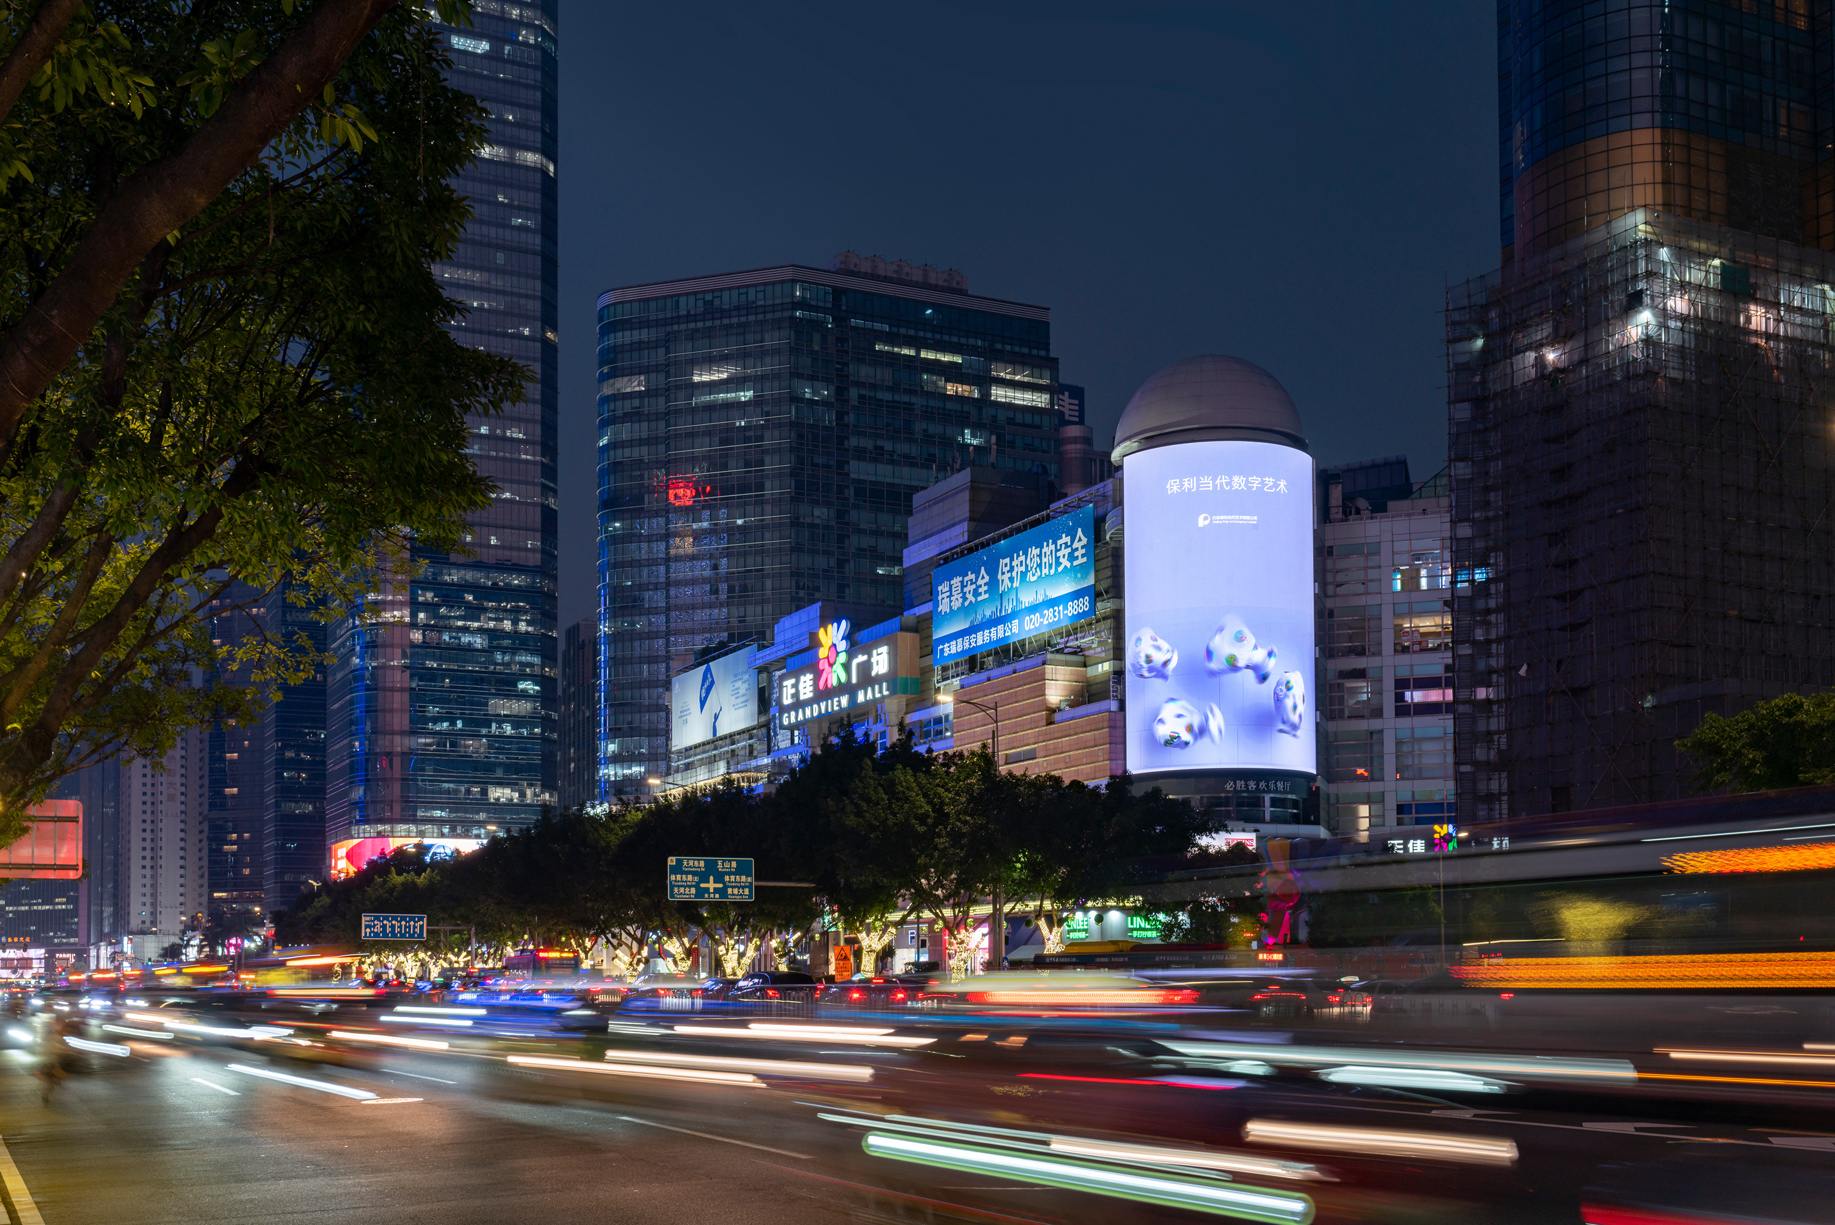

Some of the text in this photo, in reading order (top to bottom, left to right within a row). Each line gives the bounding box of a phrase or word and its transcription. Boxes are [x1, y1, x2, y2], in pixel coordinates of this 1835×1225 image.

[1166, 475, 1288, 494] 保利当代数字艺术
[937, 527, 1088, 616] 瑞慕安全 保护您的安全
[937, 596, 1090, 659] 广东瑞慕保安服务有限公司 020-2831-8888
[782, 672, 814, 705] 正佳
[852, 645, 890, 685] 广场
[782, 682, 890, 725] GRANDVIEW MALL
[1224, 780, 1291, 791] 必胜客欢乐餐厅
[673, 887, 696, 895] 天河北路
